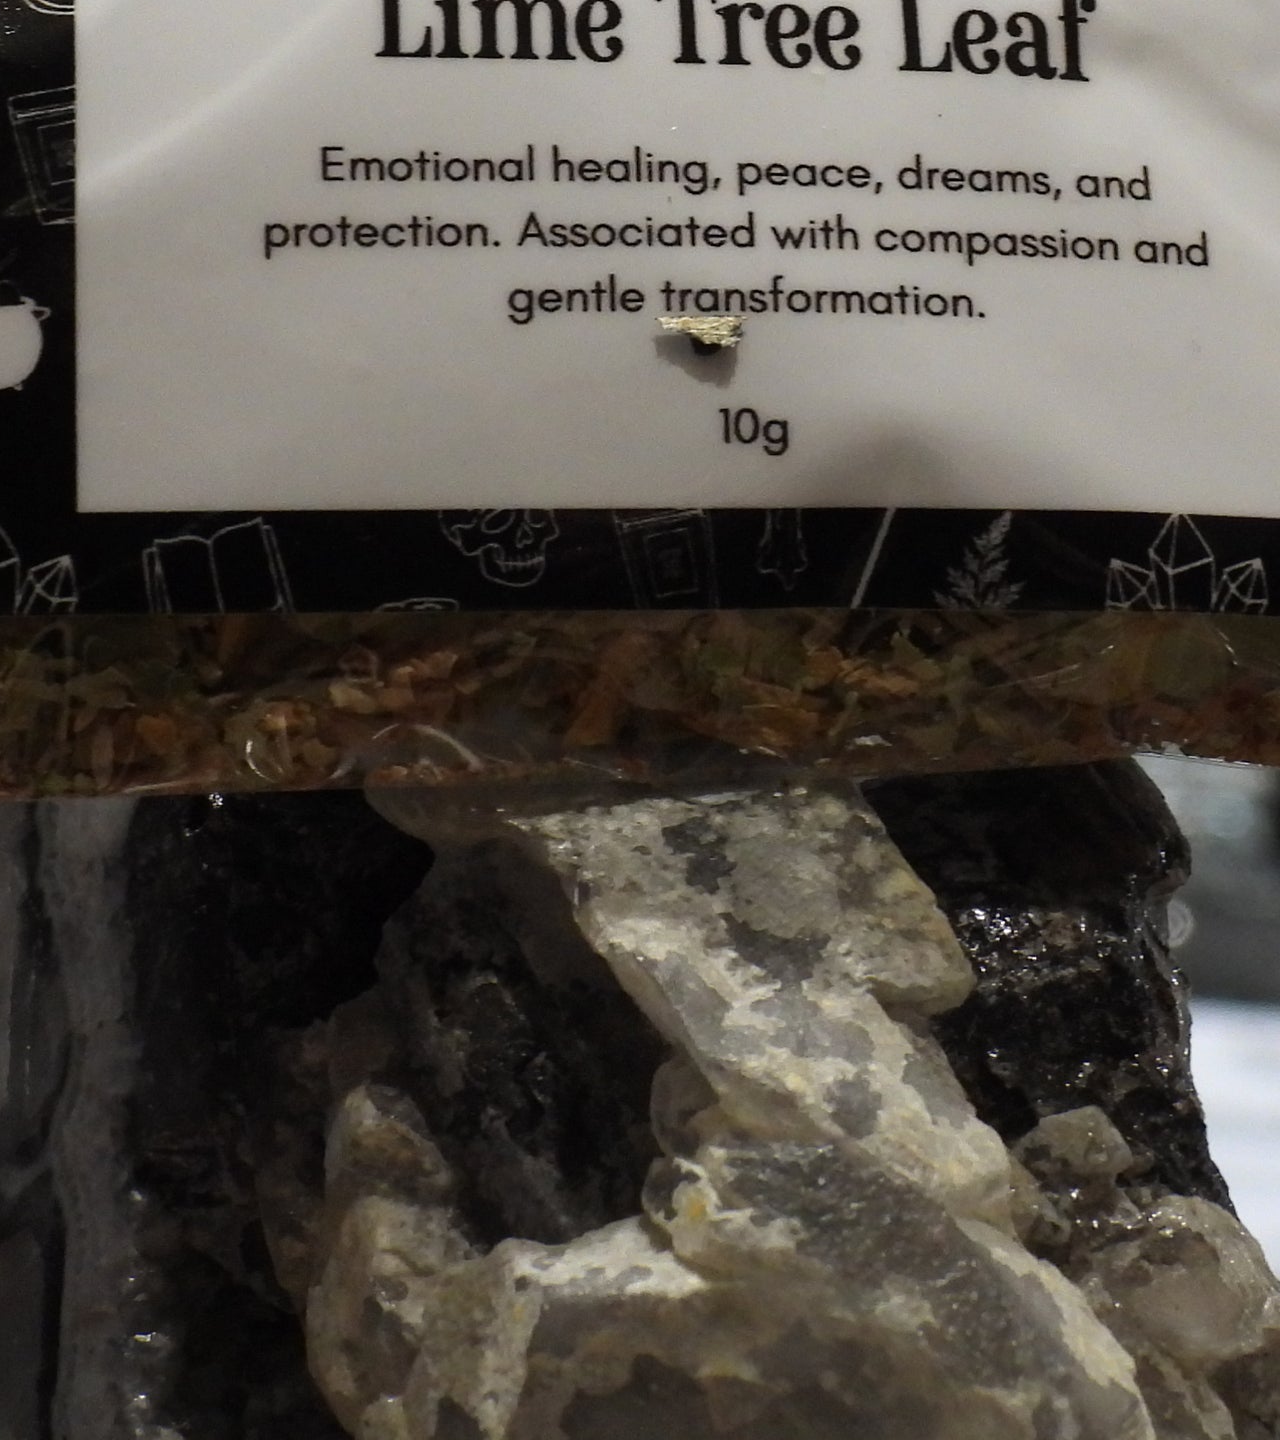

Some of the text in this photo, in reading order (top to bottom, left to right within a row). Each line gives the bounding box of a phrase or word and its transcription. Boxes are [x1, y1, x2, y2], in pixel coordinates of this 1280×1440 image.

[320, 144, 1152, 201] Emotional healing, peace, dreams, and
[263, 211, 1210, 267] protection. Associated with compassion and
[507, 273, 986, 325] gentle transformation.
[718, 407, 790, 457] 10g
